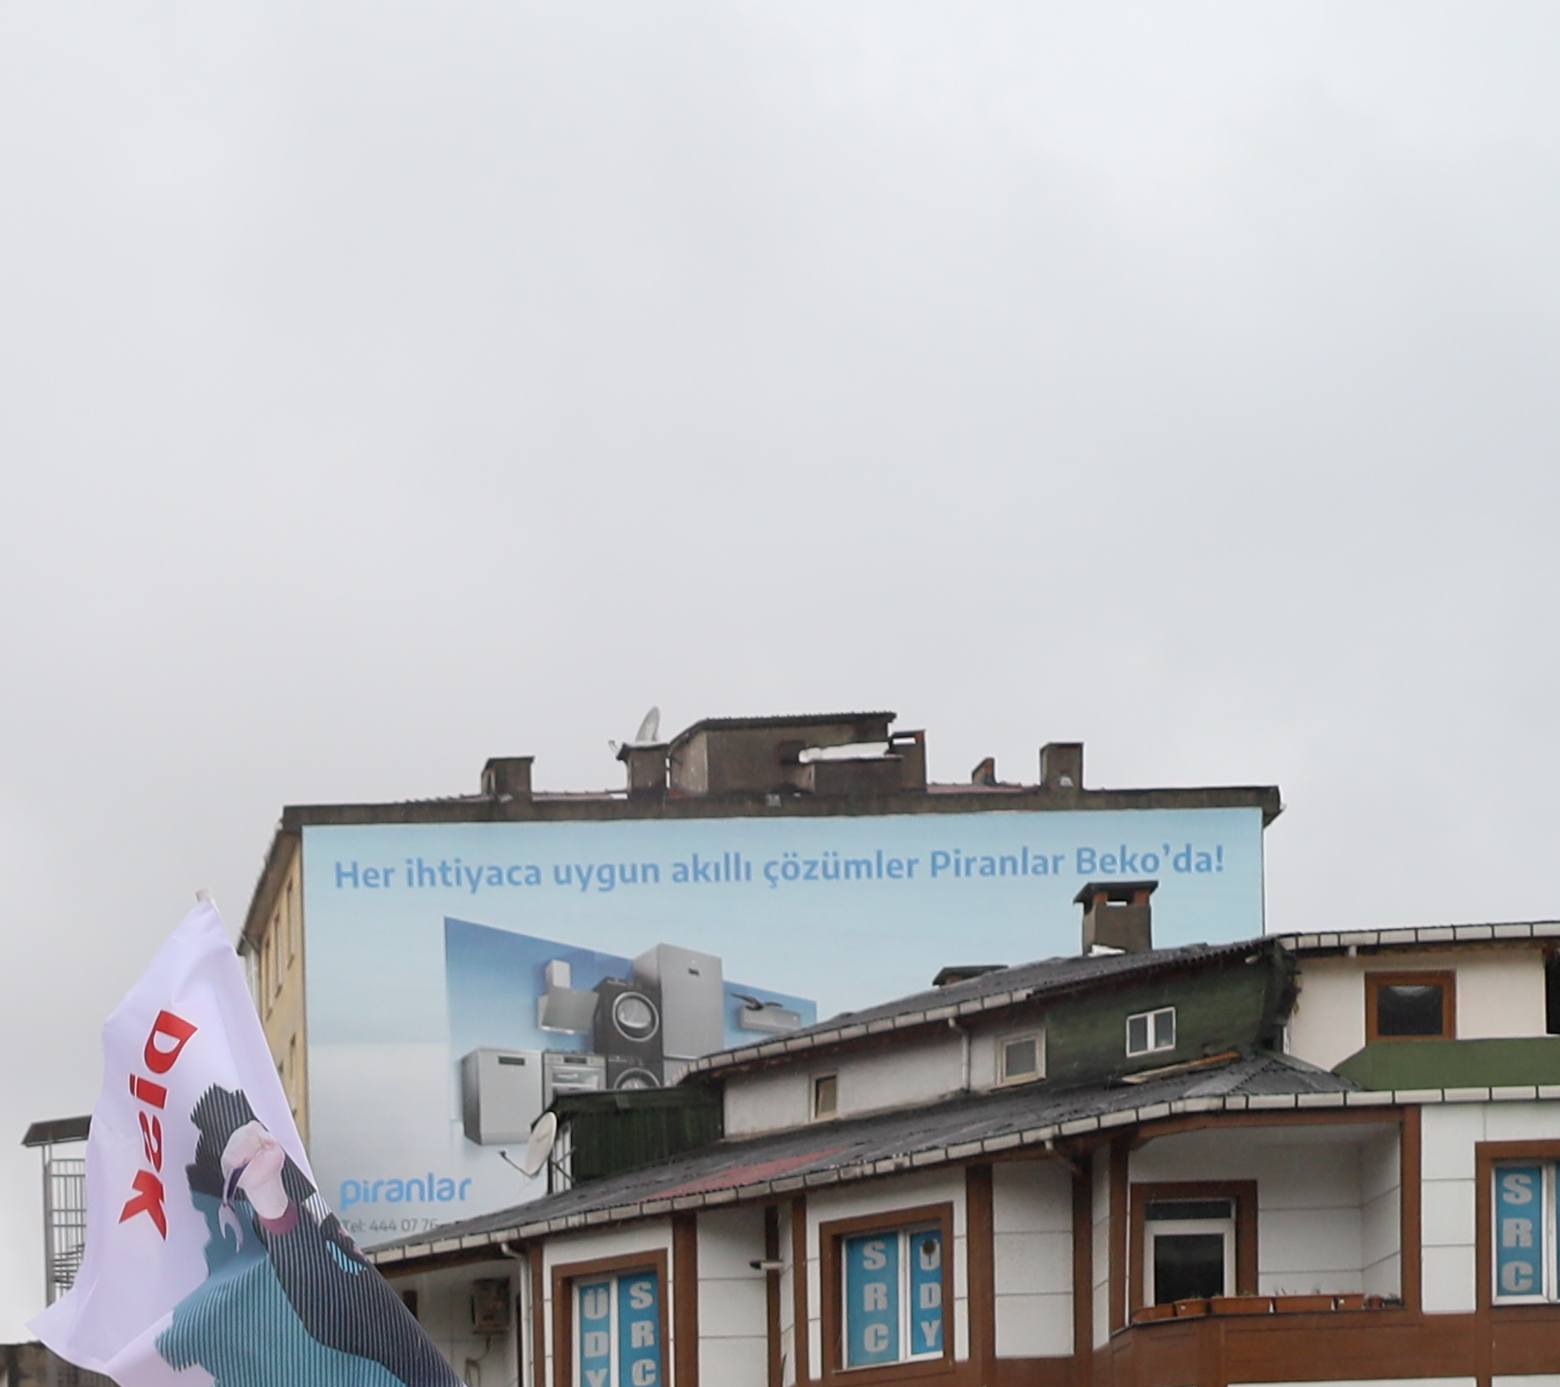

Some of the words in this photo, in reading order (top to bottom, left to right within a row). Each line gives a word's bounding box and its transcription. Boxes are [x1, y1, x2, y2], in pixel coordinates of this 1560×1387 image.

[334, 861, 394, 889] Her
[406, 858, 542, 894] ihtiyaca
[553, 861, 661, 892] uygun
[672, 853, 752, 883] akıllı
[764, 849, 920, 889] çözümler
[930, 846, 1064, 878] Piranlar
[1077, 844, 1225, 875] Beko’da!
[340, 1172, 472, 1212] piranlar
[1501, 1173, 1533, 1292] SRC
[630, 1281, 657, 1387] SRC
[863, 1240, 889, 1353] SRC
